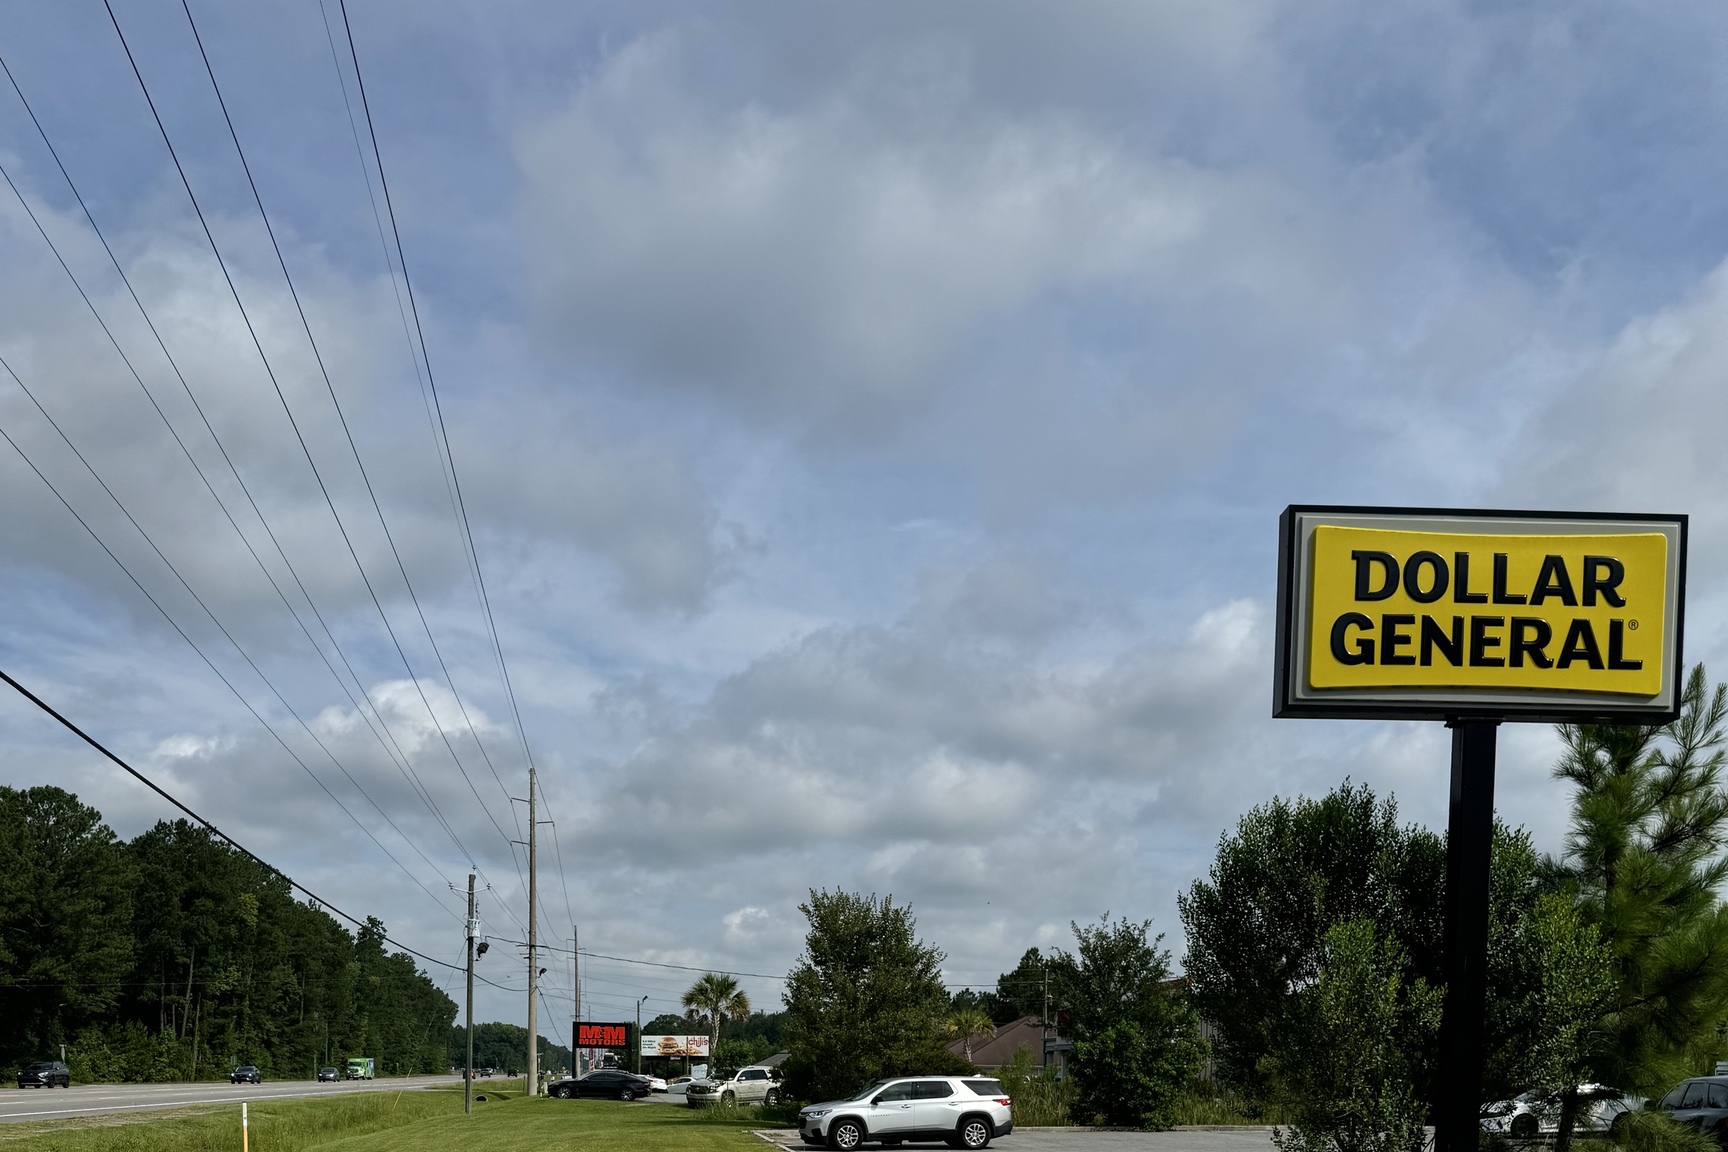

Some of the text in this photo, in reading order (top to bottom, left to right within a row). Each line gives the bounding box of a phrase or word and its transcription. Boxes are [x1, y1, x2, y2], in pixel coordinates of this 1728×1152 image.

[1351, 549, 1627, 608] DOLLAR
[1330, 612, 1643, 671] GENERAL
[579, 1025, 626, 1039] M&M
[579, 1038, 626, 1046] MOTORS
